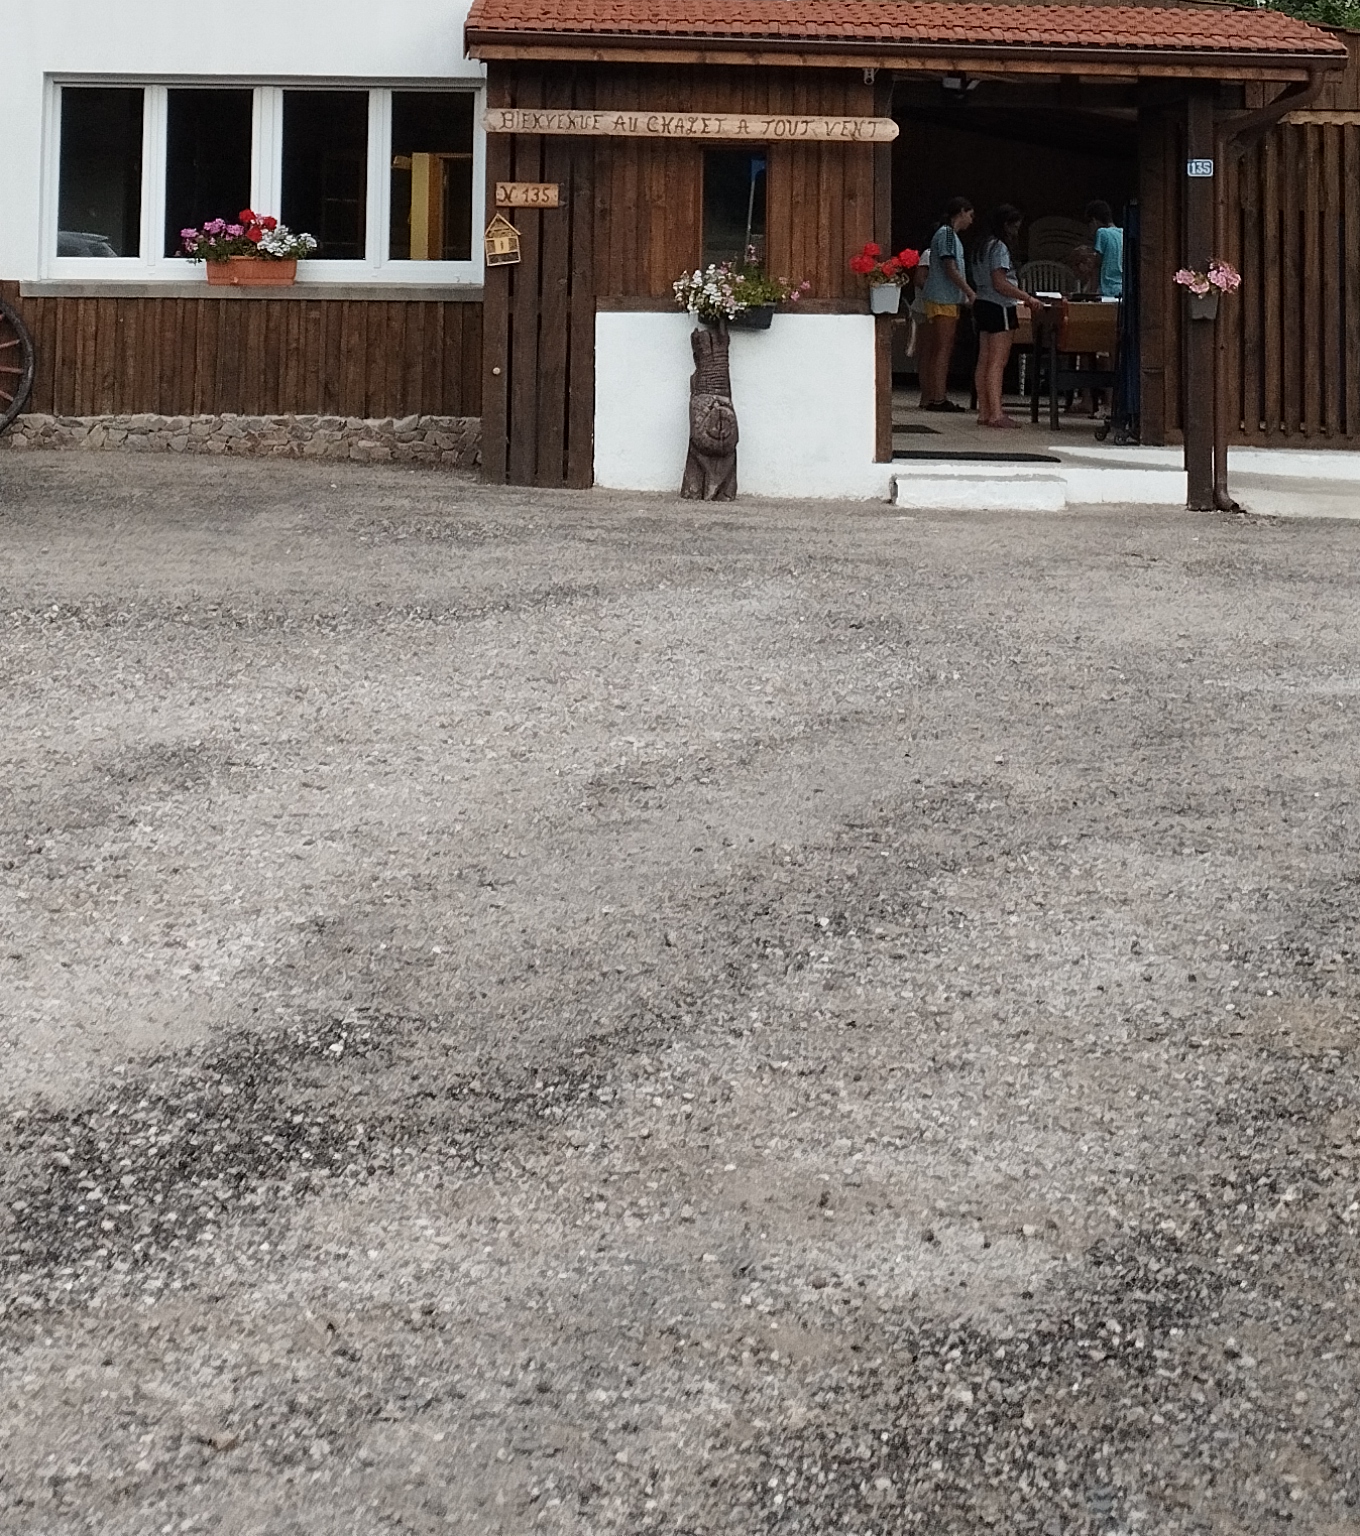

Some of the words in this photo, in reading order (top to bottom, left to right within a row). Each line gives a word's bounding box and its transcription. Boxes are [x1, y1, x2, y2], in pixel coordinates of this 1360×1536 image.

[499, 111, 604, 131] BIENVENUE
[612, 114, 639, 133] AU
[646, 115, 728, 135] CHALET
[735, 118, 750, 135] A
[761, 118, 815, 137] TOUT
[824, 120, 880, 138] VENT
[1191, 162, 1211, 174] 135
[522, 186, 551, 204] 135
